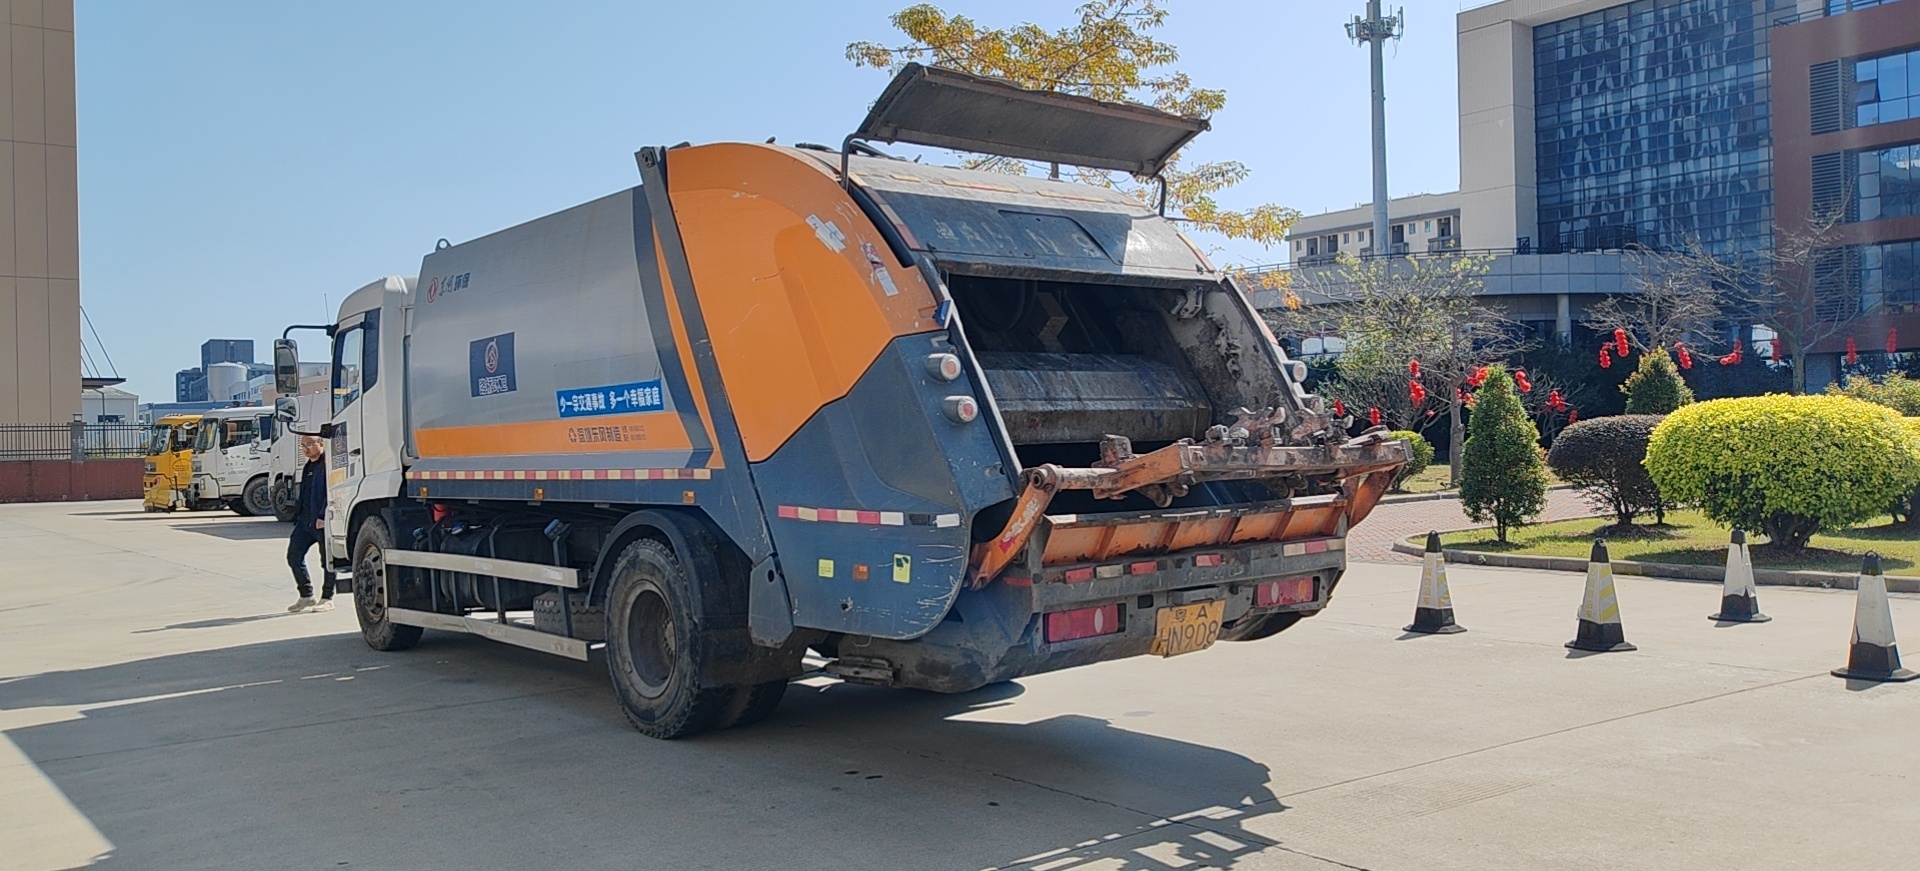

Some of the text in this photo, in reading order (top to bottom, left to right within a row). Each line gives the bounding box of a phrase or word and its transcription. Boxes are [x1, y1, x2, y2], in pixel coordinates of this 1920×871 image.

[559, 386, 661, 413] 少一宗交通事故 多一个幸福家庭
[1155, 620, 1219, 653] HN908
